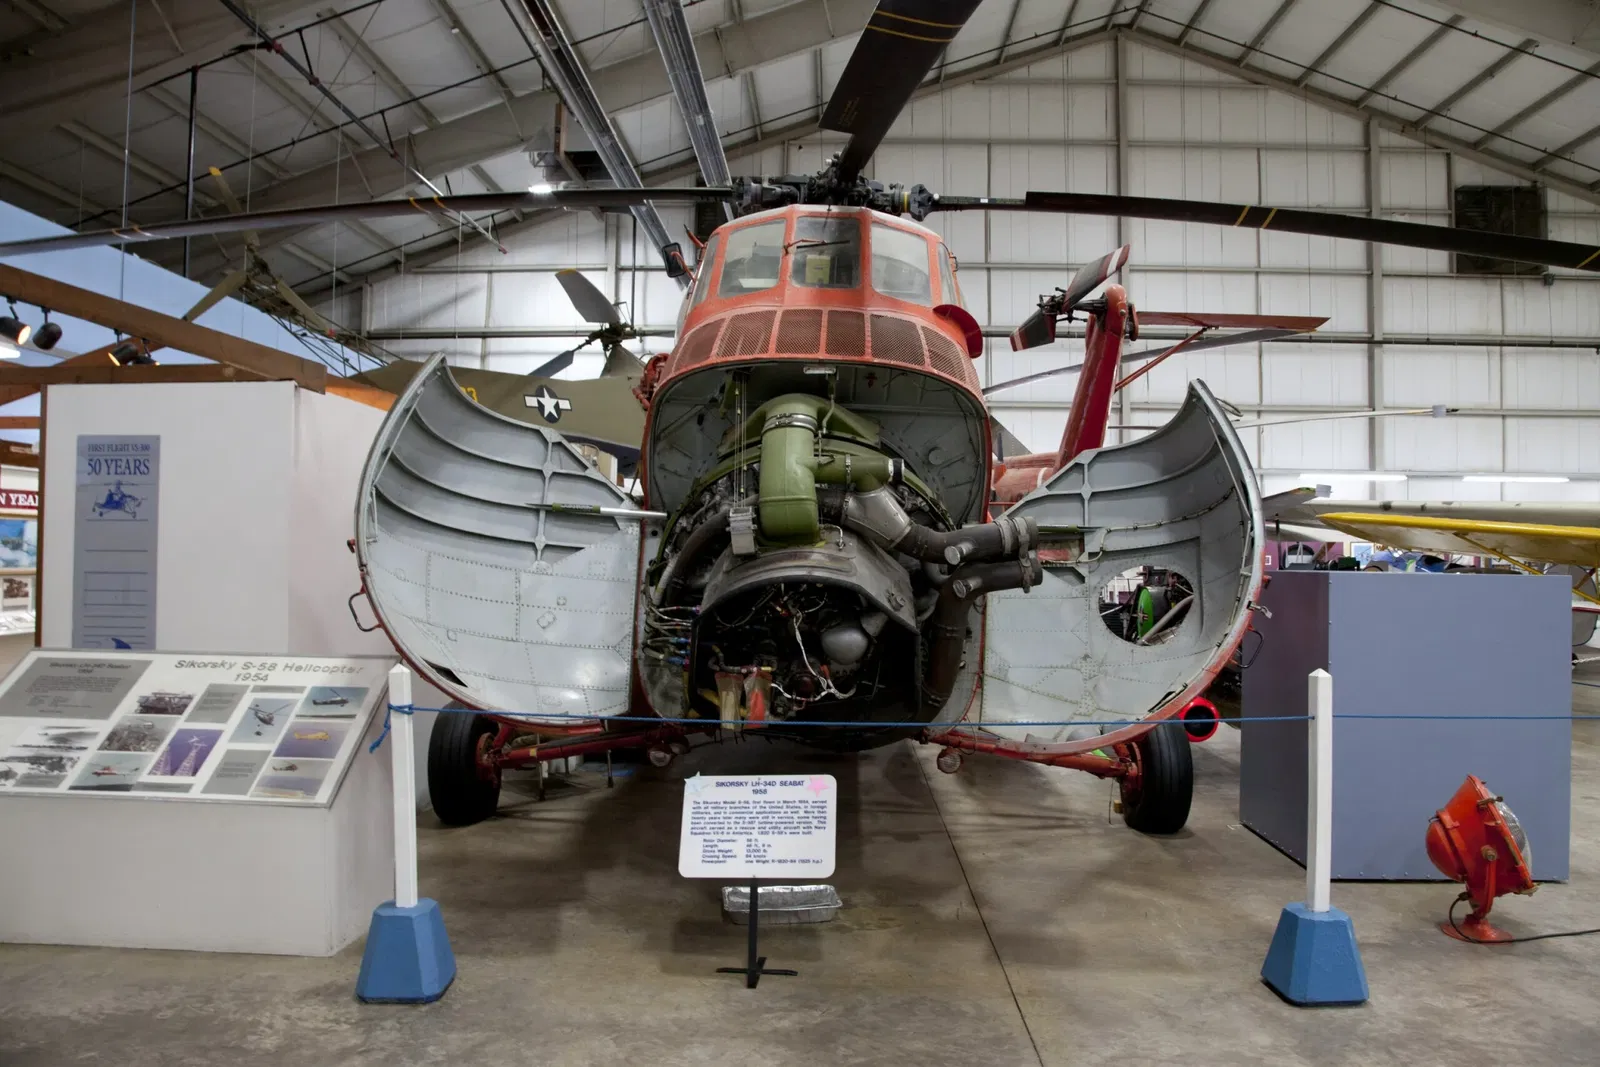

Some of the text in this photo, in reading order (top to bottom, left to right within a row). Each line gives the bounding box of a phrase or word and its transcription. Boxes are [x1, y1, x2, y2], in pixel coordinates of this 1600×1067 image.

[88, 444, 105, 452] FIRST
[106, 444, 130, 452] FLIGHT
[87, 458, 150, 476] 50 YEARS
[9, 493, 39, 506] YEA
[174, 659, 364, 674] Sikorsky S-58 Helicopter
[234, 673, 270, 682] 1954
